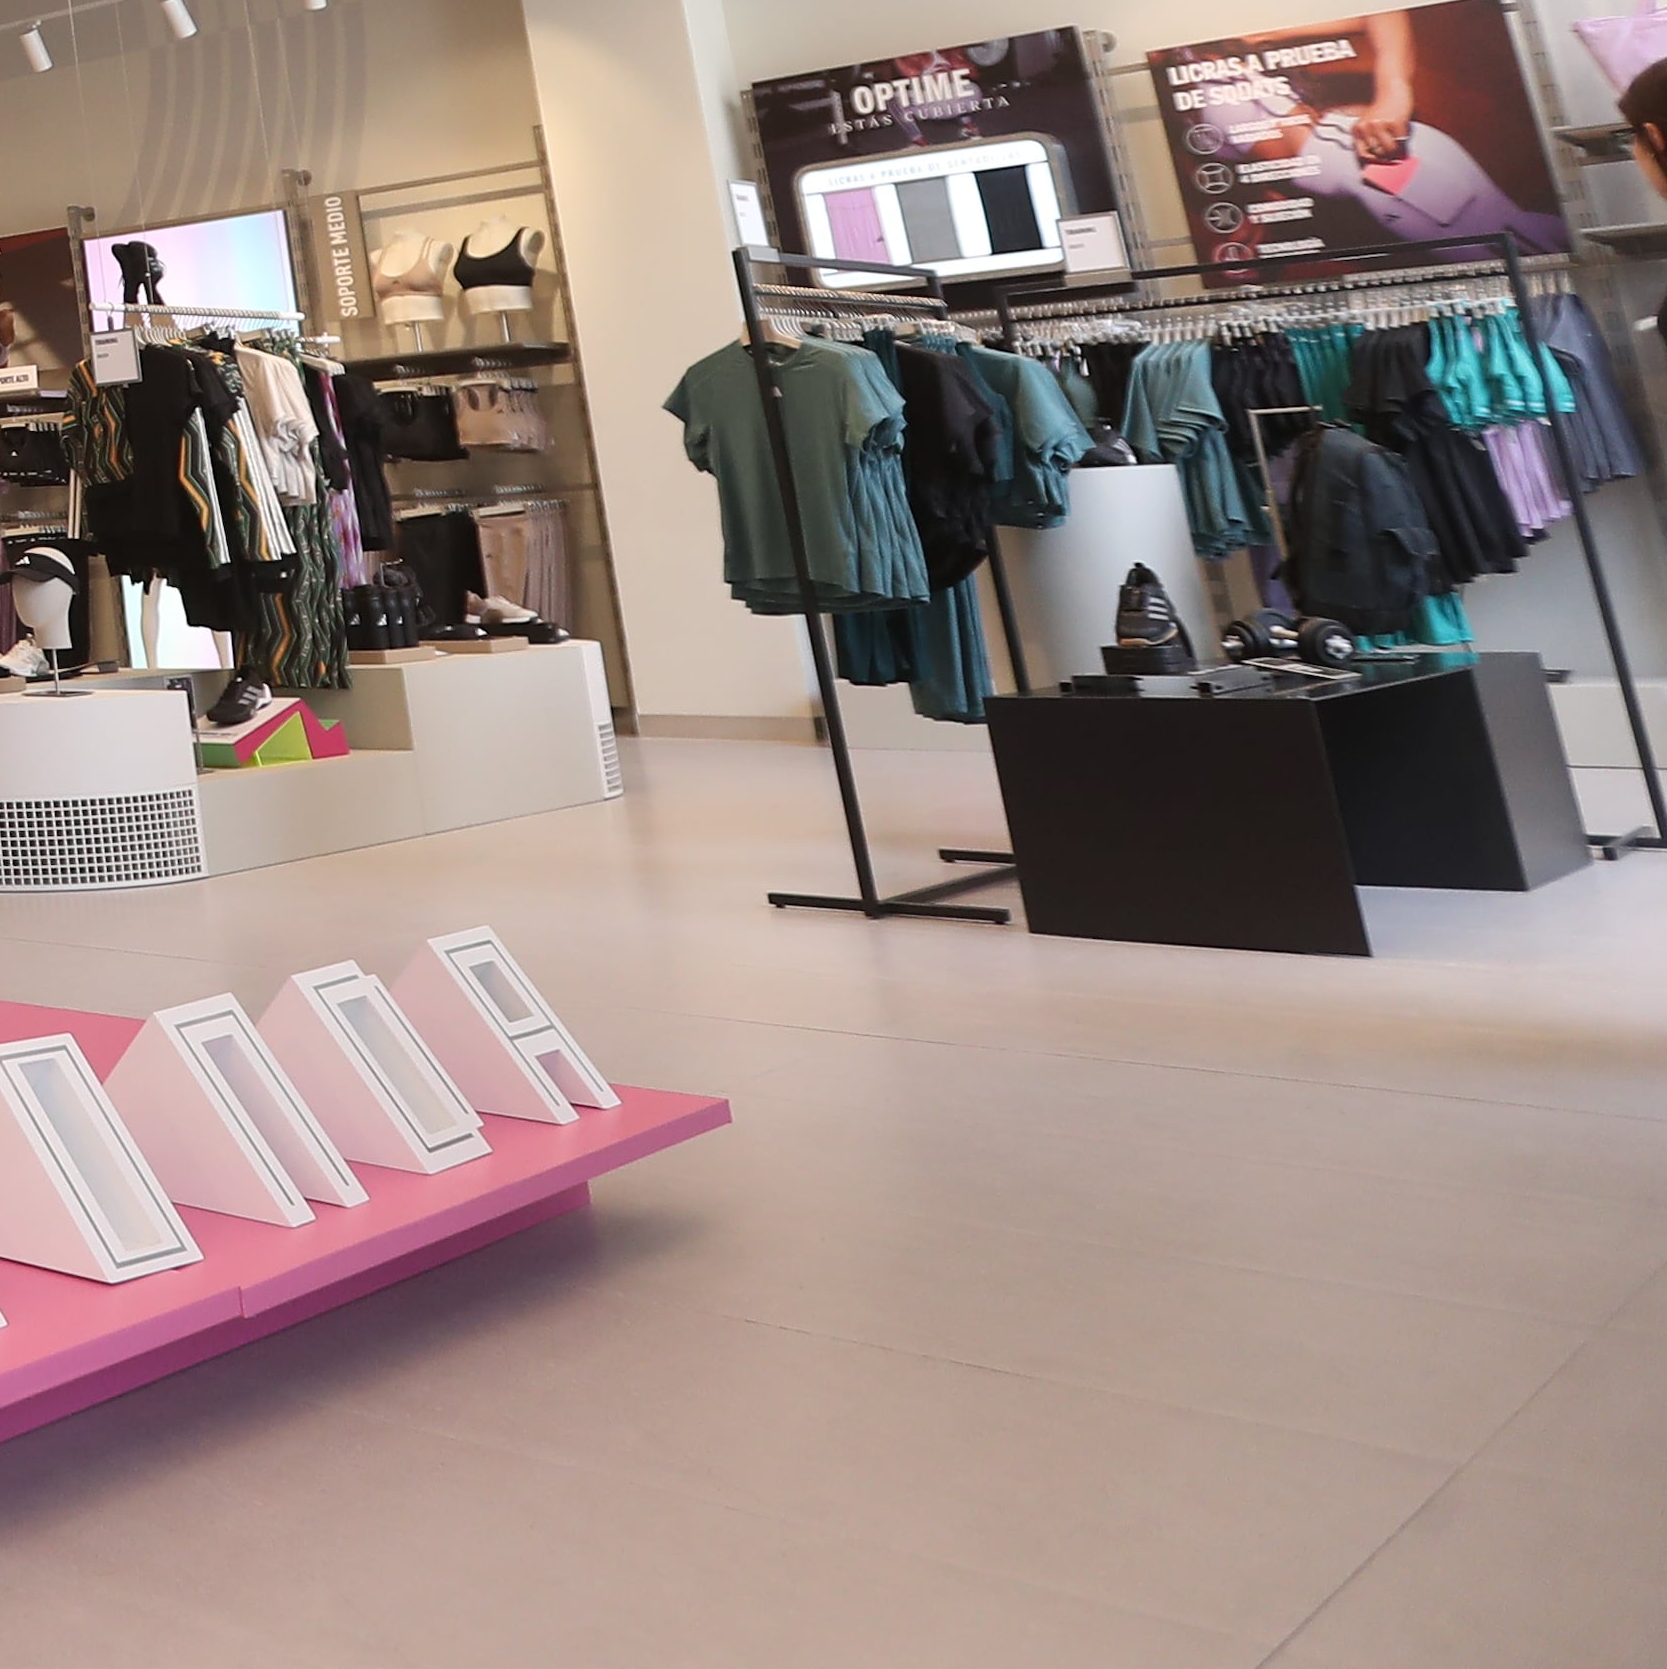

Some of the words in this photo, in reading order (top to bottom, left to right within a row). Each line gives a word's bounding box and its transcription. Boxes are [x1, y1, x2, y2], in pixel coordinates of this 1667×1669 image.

[1167, 57, 1244, 86] LICRAS
[1245, 54, 1264, 73] A
[1264, 39, 1357, 70] PRUEBA
[852, 68, 975, 115] OPTIME
[904, 95, 1010, 121] CUBIERTA
[1173, 89, 1206, 111] DE
[325, 196, 348, 245] MEDIO
[332, 247, 359, 318] SOPORTE
